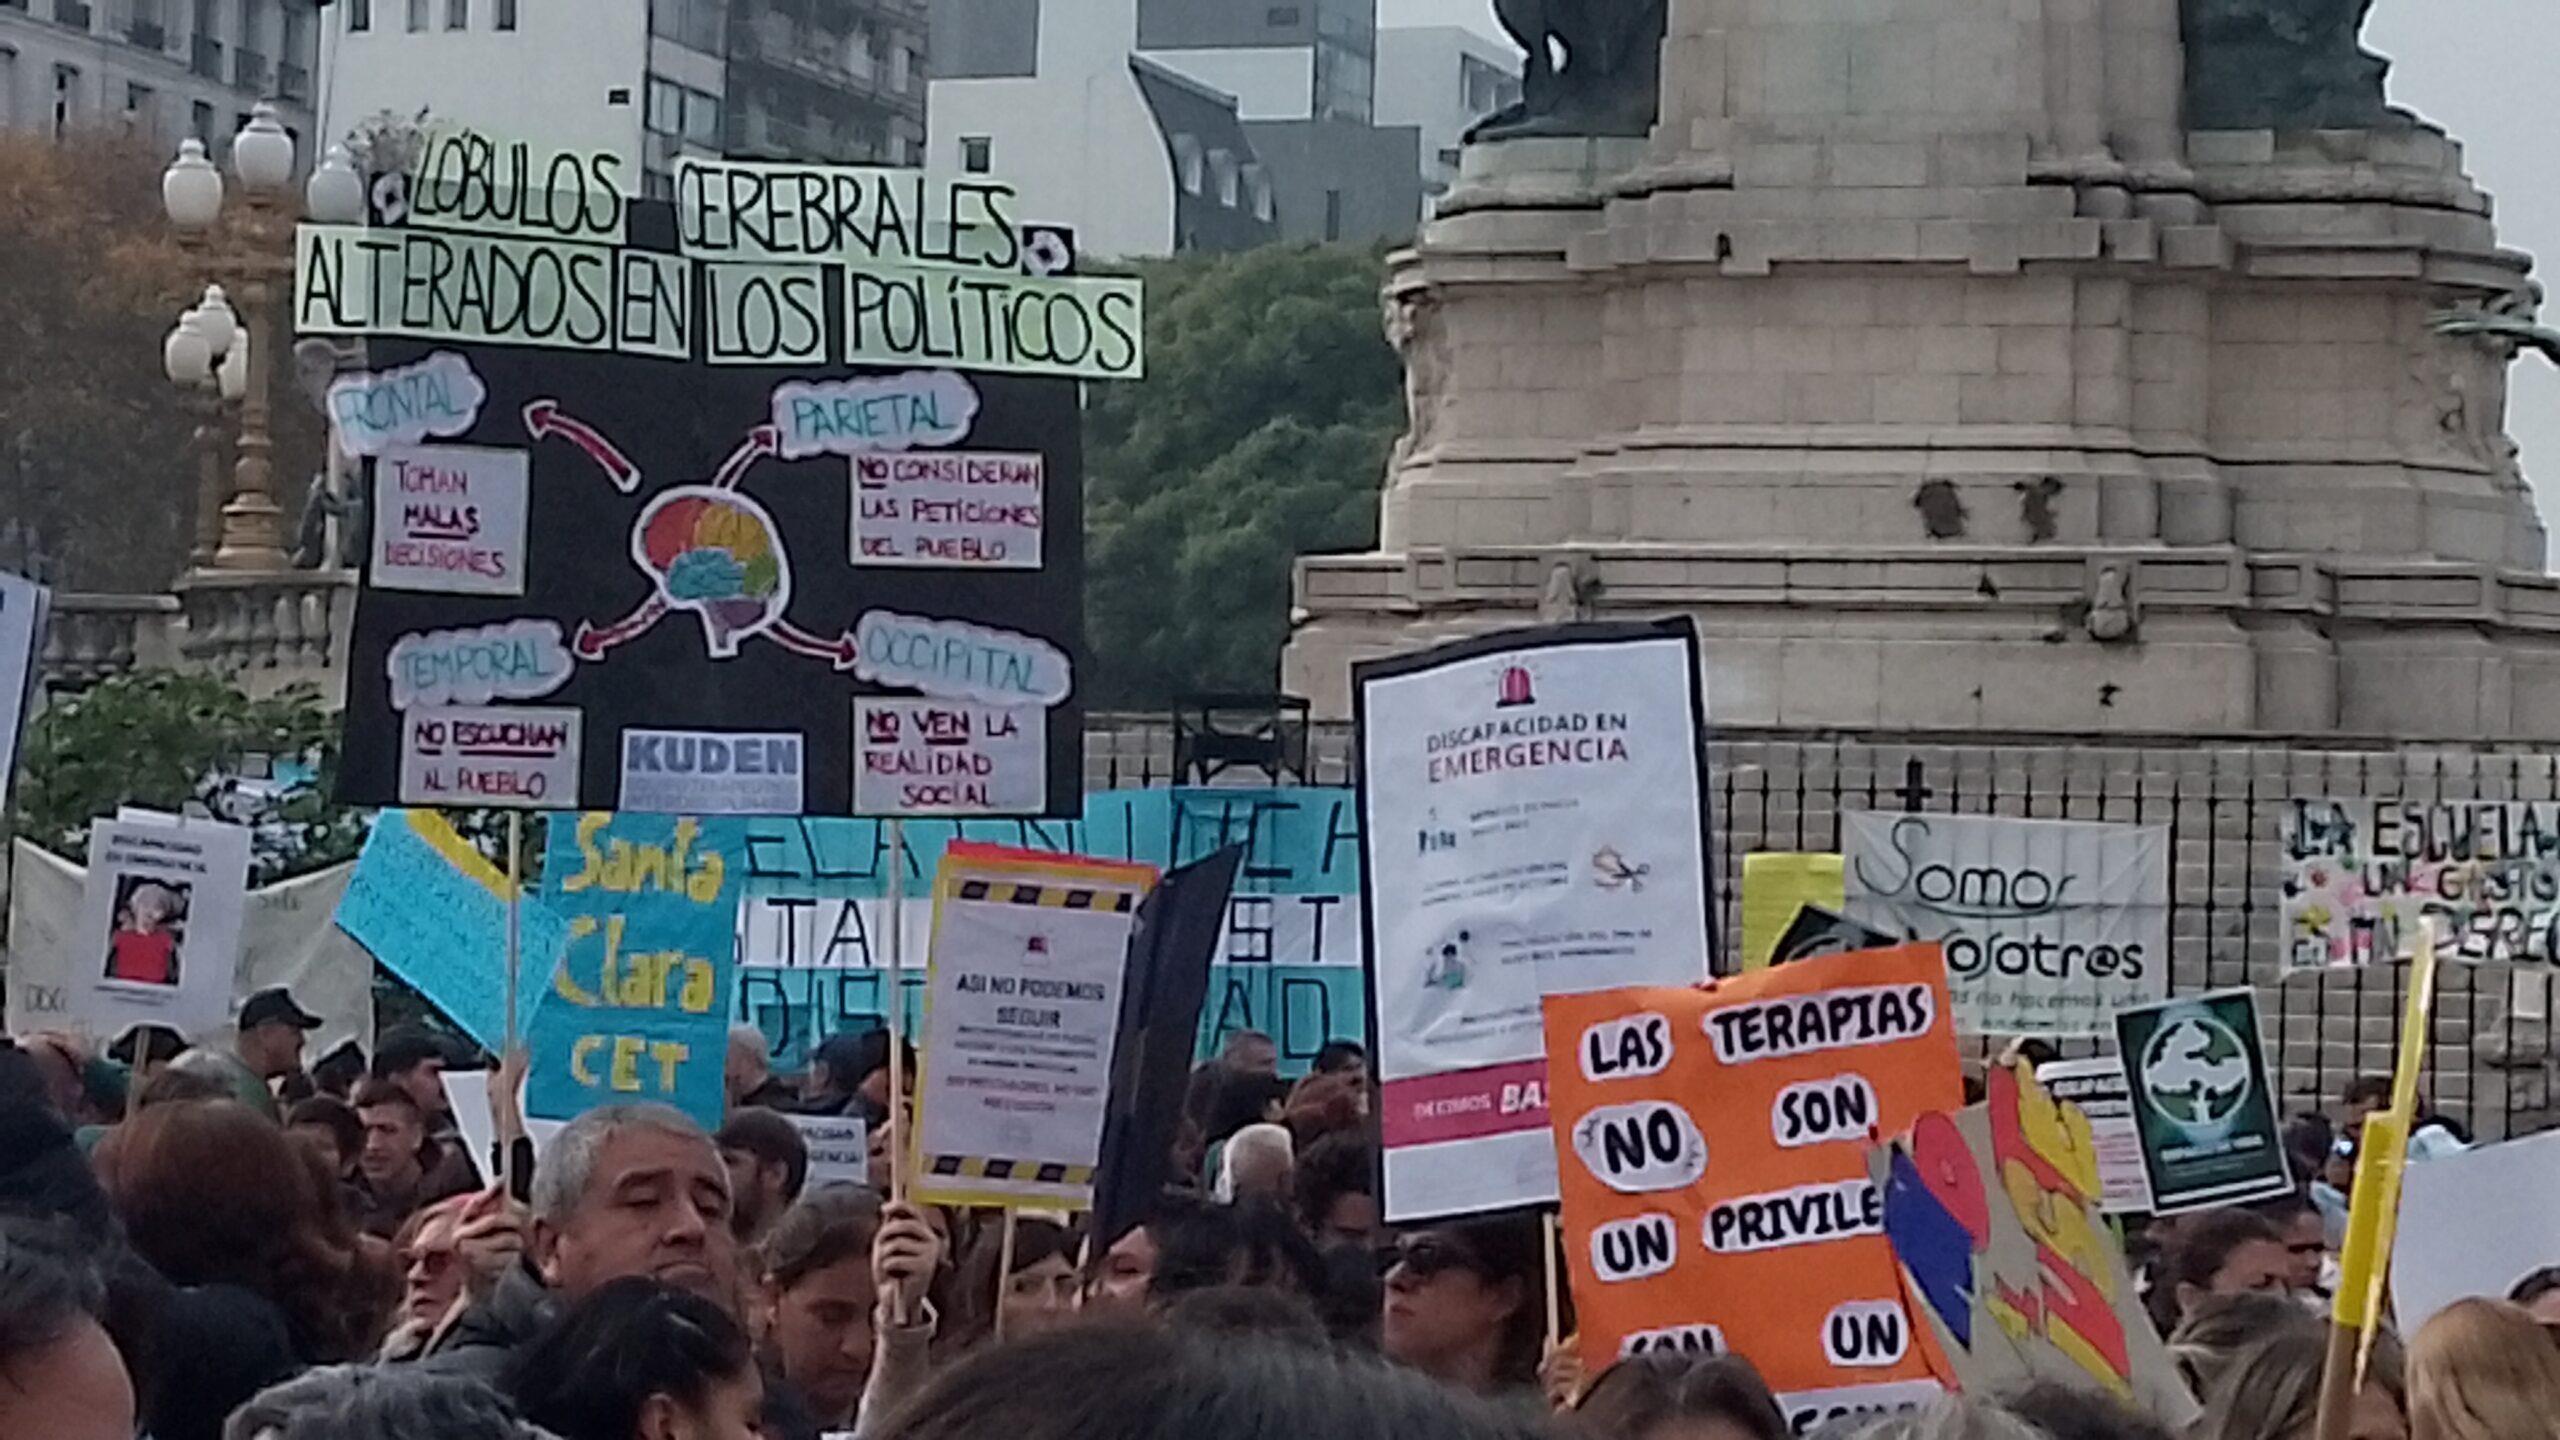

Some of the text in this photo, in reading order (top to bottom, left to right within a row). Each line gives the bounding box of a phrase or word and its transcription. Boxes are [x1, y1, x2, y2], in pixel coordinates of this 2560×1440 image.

[679, 162, 1018, 268] CEREBRALES
[303, 235, 606, 342] ALTERADOS
[621, 255, 685, 349] EN
[709, 269, 820, 358] LOS
[336, 370, 466, 431] FRONTAL
[791, 391, 957, 438] PARIETAL
[393, 460, 466, 495] TOMAN
[858, 456, 1039, 490] NO CONSIDERAN
[404, 506, 480, 535] MALAS
[861, 498, 1040, 528] LAS PETICIONES
[385, 541, 504, 578] DECISIONES
[861, 537, 1006, 560] DEL PUEBLO
[400, 637, 551, 688] TEMPORAL
[415, 721, 568, 747] NO ESCUCHAN
[866, 710, 1018, 737] NO VEN LA
[1427, 712, 1628, 753] DISCAPACIDAD EN
[627, 735, 798, 775] KUDEN
[865, 749, 992, 775] REALIDAD
[1429, 737, 1629, 783] EMERGENCIA
[424, 771, 545, 799] AL PUEBLO
[903, 783, 992, 806] SOCIAL
[2373, 800, 2546, 862] ESCUELA
[564, 812, 723, 903] Santa
[556, 914, 714, 1013] Clara
[1942, 928, 2143, 981] osotr@s
[990, 977, 1015, 995] NO
[1020, 978, 1105, 1001] PODEMOS
[997, 1007, 1061, 1029] SEGUIR
[1590, 986, 1928, 1075] LAS TERAPIAS
[571, 1035, 689, 1092] CET
[1501, 1080, 1550, 1114] BA
[1604, 1083, 1867, 1175] NO SON
[1602, 1219, 1670, 1273] UN
[1831, 1314, 1899, 1360] UN
